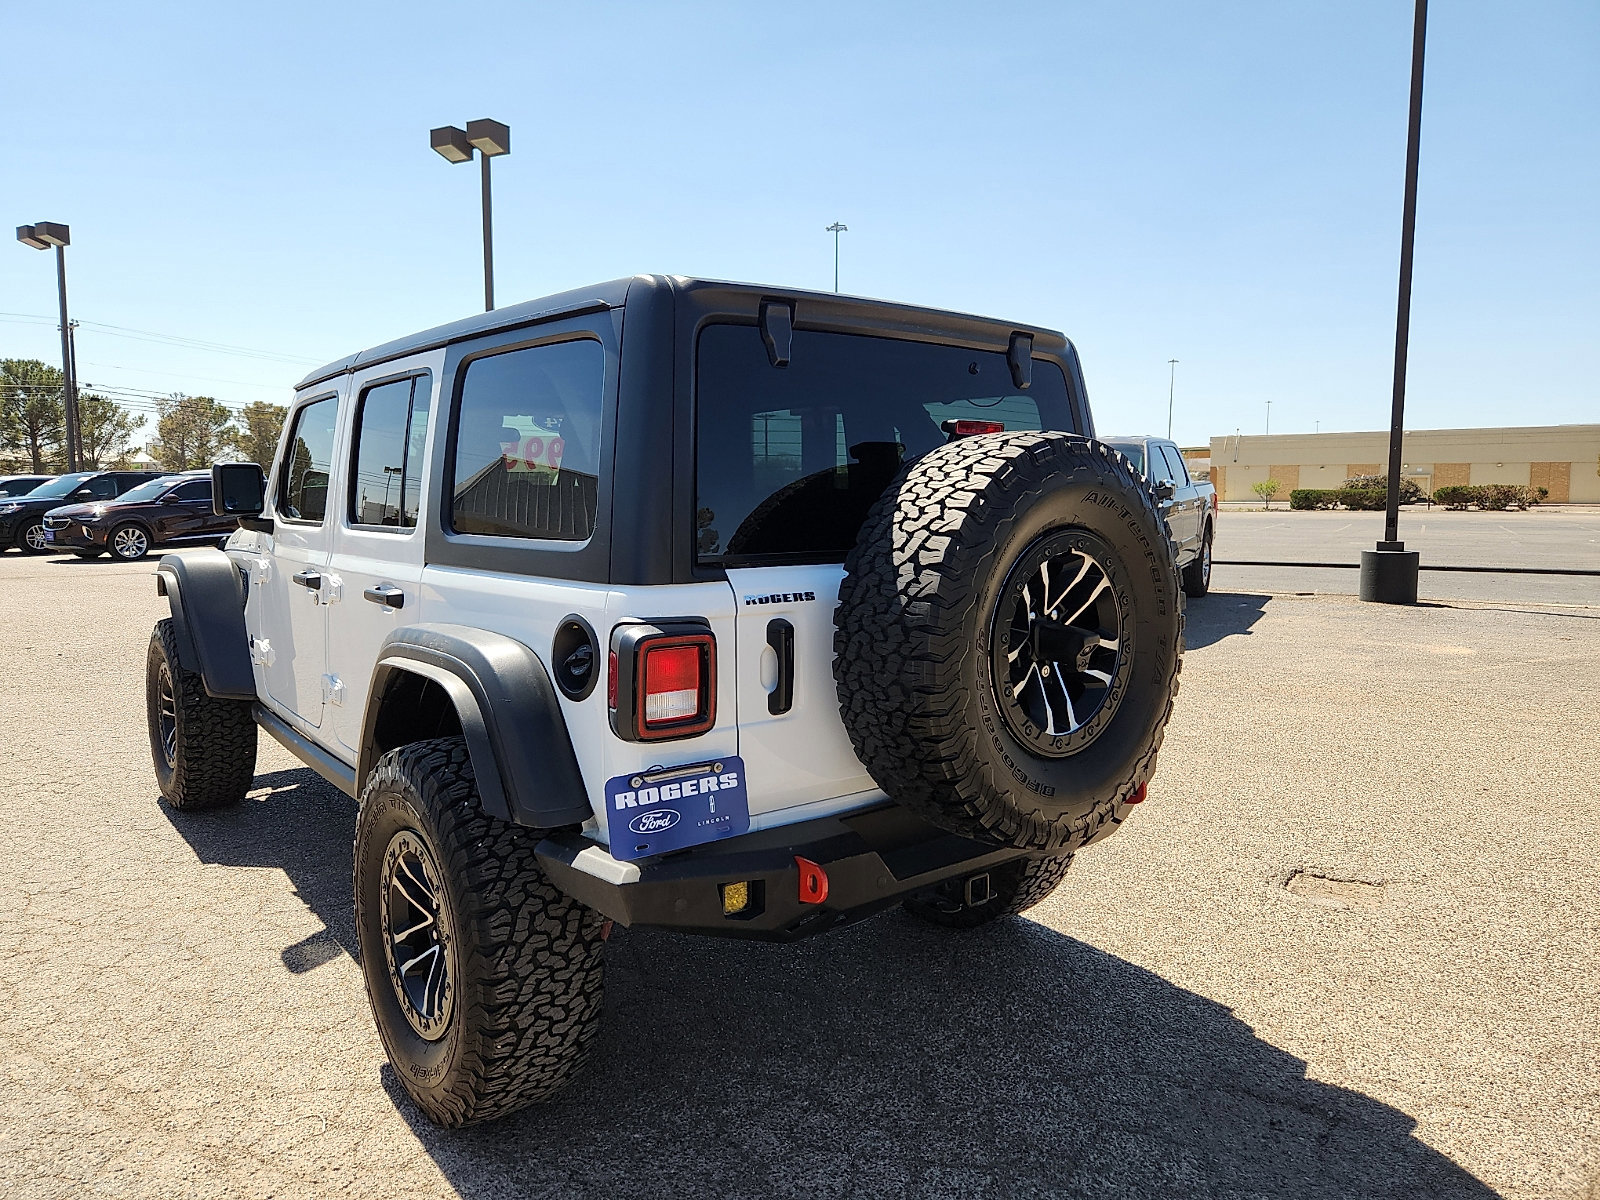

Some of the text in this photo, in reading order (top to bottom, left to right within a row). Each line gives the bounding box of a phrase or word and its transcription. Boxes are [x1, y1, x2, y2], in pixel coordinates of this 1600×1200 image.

[744, 591, 816, 606] ROGERS
[976, 627, 1056, 798] BFGoodrich
[614, 772, 739, 811] ROGERS
[639, 812, 672, 832] Ford
[697, 815, 730, 827] LINCOLN
